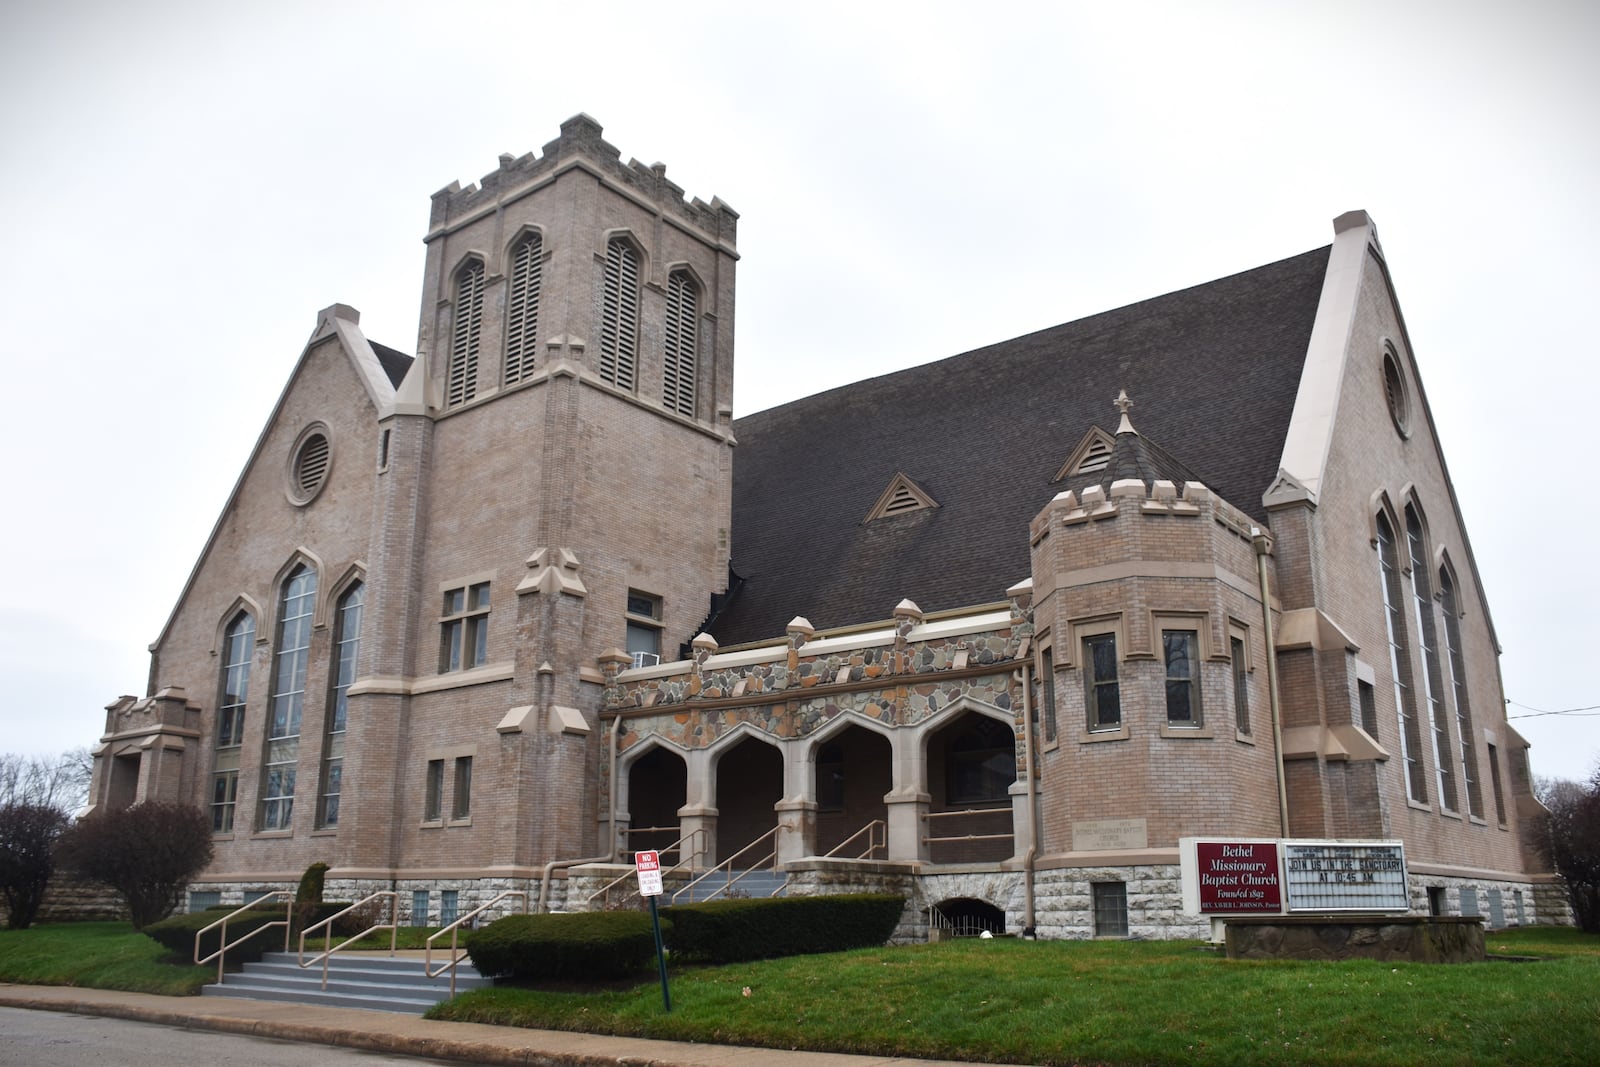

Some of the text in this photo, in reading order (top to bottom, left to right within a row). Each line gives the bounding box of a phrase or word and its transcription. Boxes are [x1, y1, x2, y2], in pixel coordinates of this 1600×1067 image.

[1222, 845, 1253, 857] Bethel
[639, 861, 657, 870] PARKING
[1210, 859, 1267, 874] Missionary
[1289, 860, 1401, 870] JOIN US IN THE SANCTUARY
[1202, 873, 1277, 887] Baptist Church
[1319, 873, 1374, 882] AT 10:45 AM
[1217, 888, 1264, 900] Founded 1892
